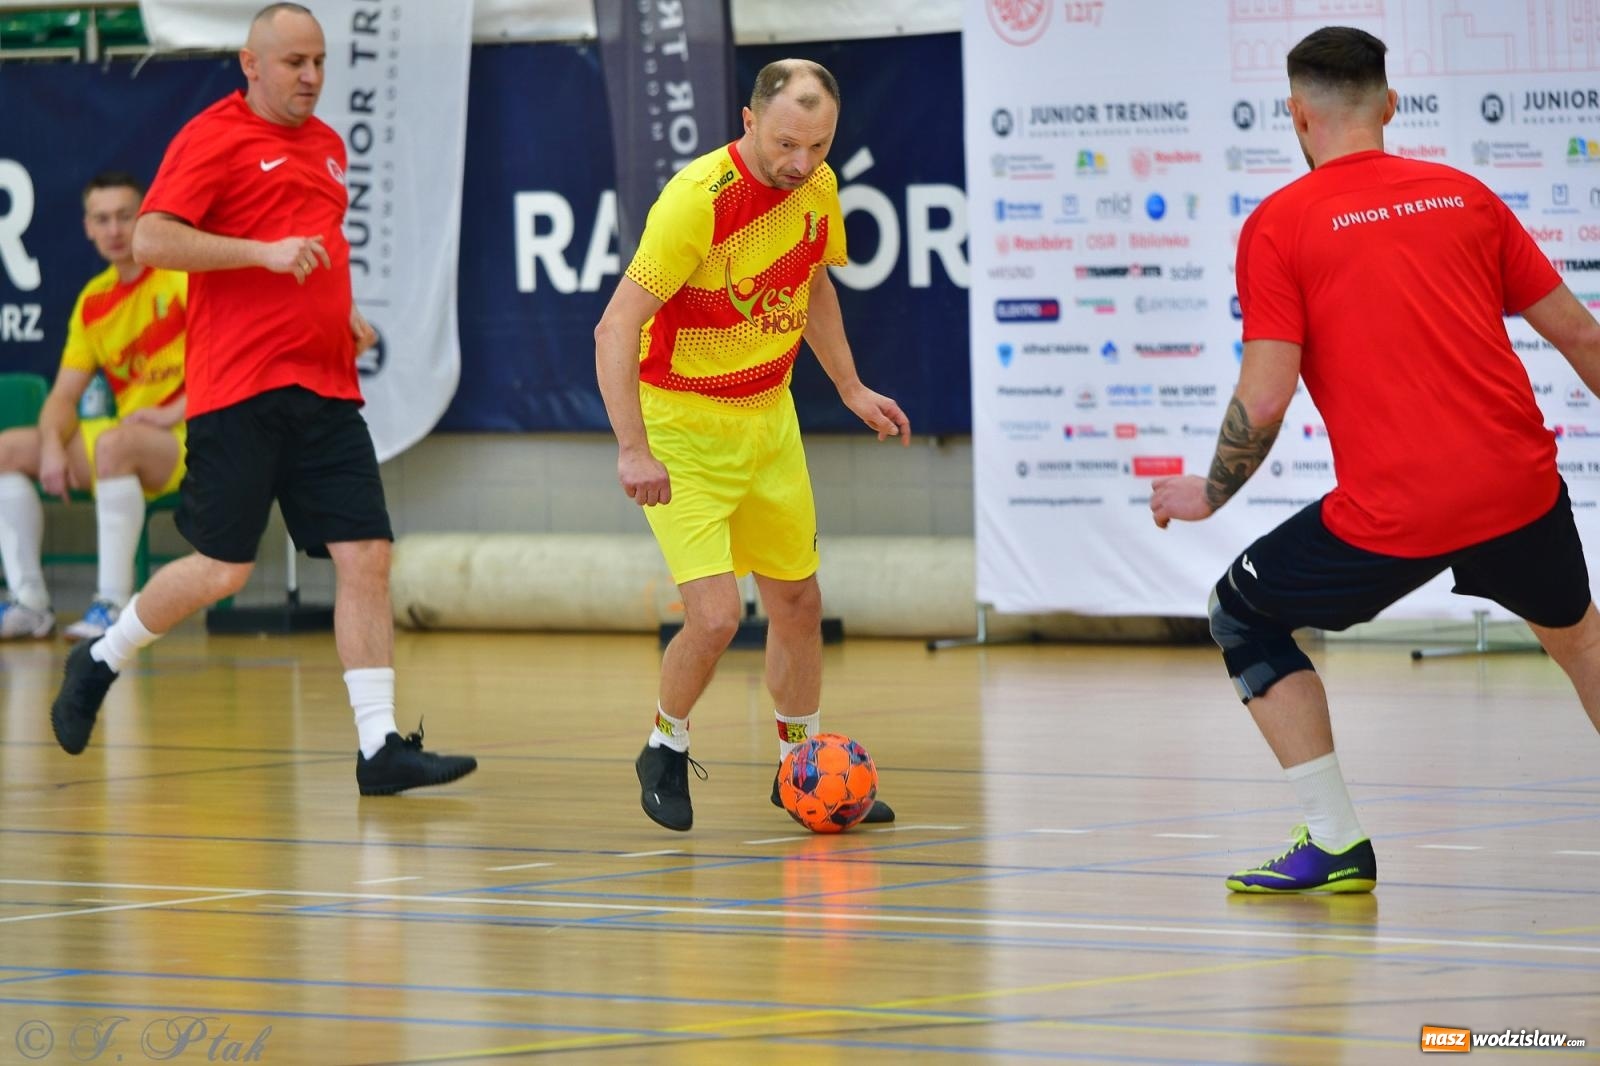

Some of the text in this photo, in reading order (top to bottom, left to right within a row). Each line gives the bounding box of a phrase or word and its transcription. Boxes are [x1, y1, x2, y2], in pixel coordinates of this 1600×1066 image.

[349, 0, 381, 68] TR
[1029, 102, 1188, 125] JUNIOR TRENING
[1523, 90, 1600, 111] JUNIOR
[1332, 195, 1465, 231] JUNIOR TRENING
[0, 304, 44, 342] RZ
